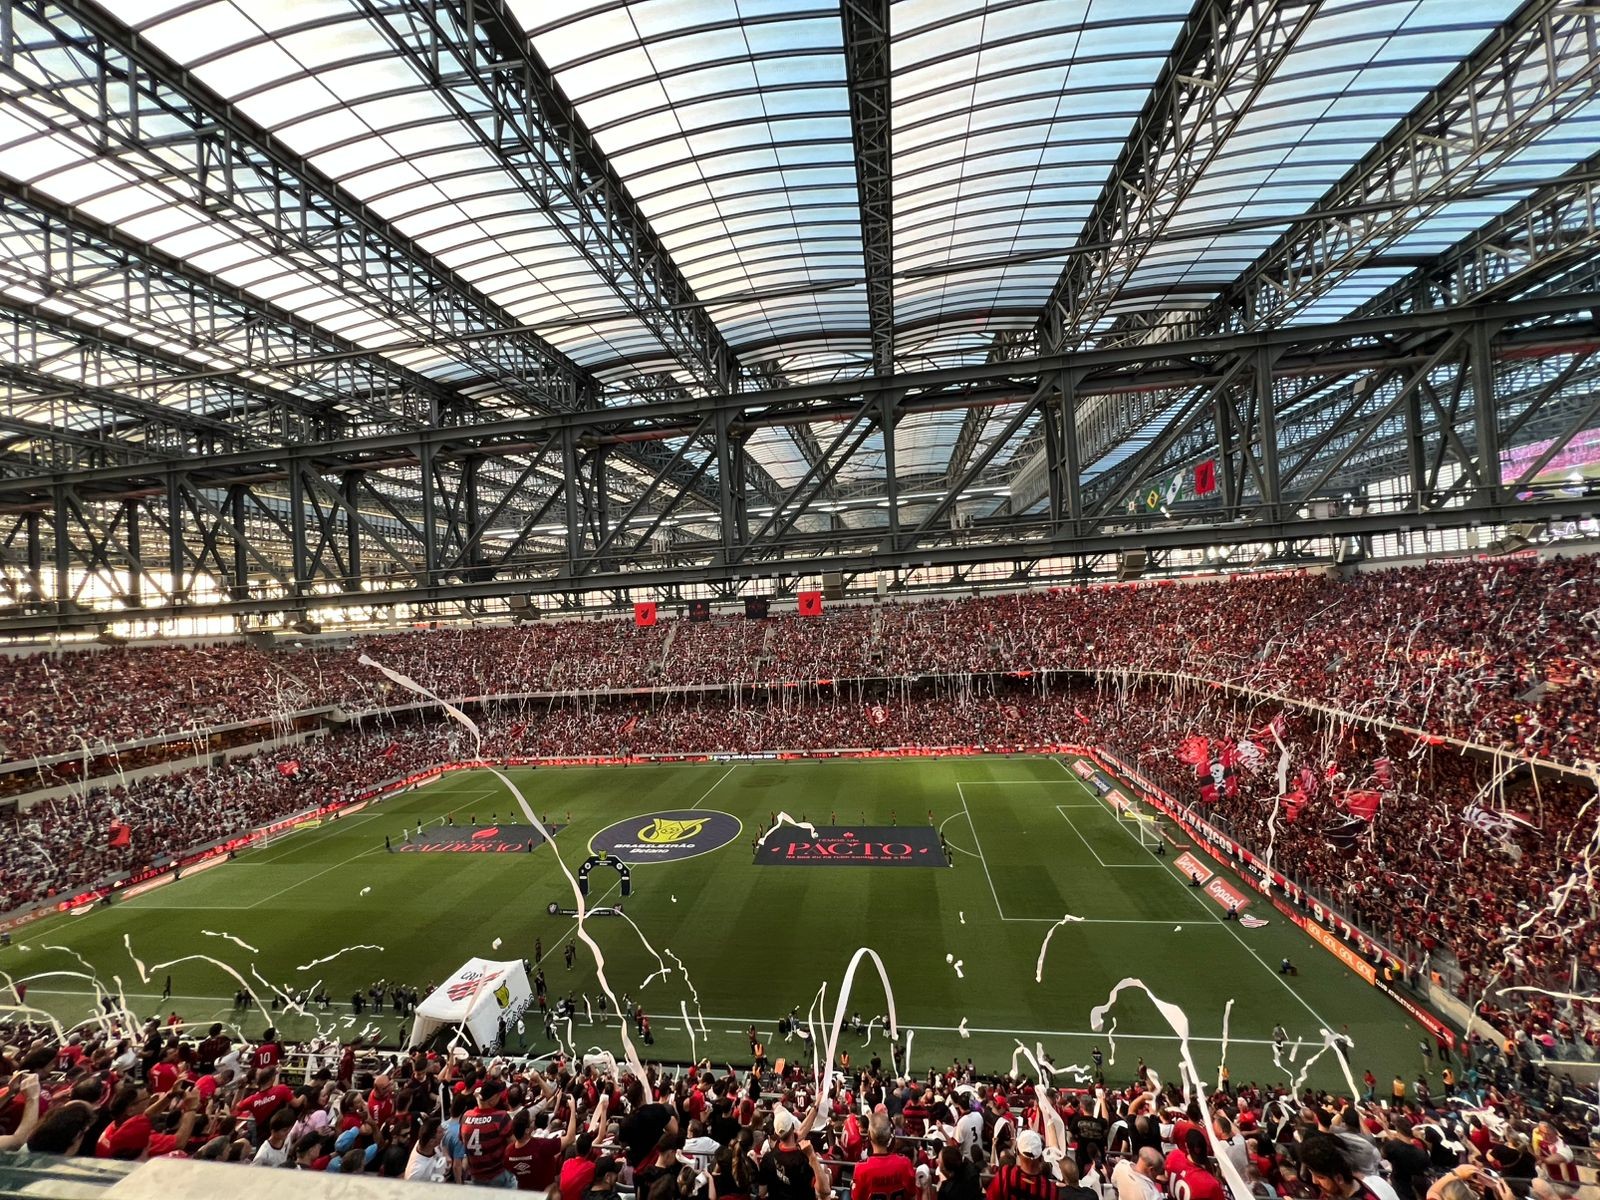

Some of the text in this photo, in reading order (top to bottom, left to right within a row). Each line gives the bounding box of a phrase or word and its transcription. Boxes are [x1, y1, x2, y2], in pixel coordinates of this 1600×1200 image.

[787, 842, 913, 855] PACTO
[1308, 923, 1373, 980] GOL GOL GOL GOL
[259, 1052, 271, 1066] 10
[253, 1094, 276, 1108] Philco
[464, 1115, 492, 1125] ALFREDO
[466, 1128, 483, 1156] 4
[970, 1126, 978, 1143] 3
[1169, 1171, 1191, 1200] 10
